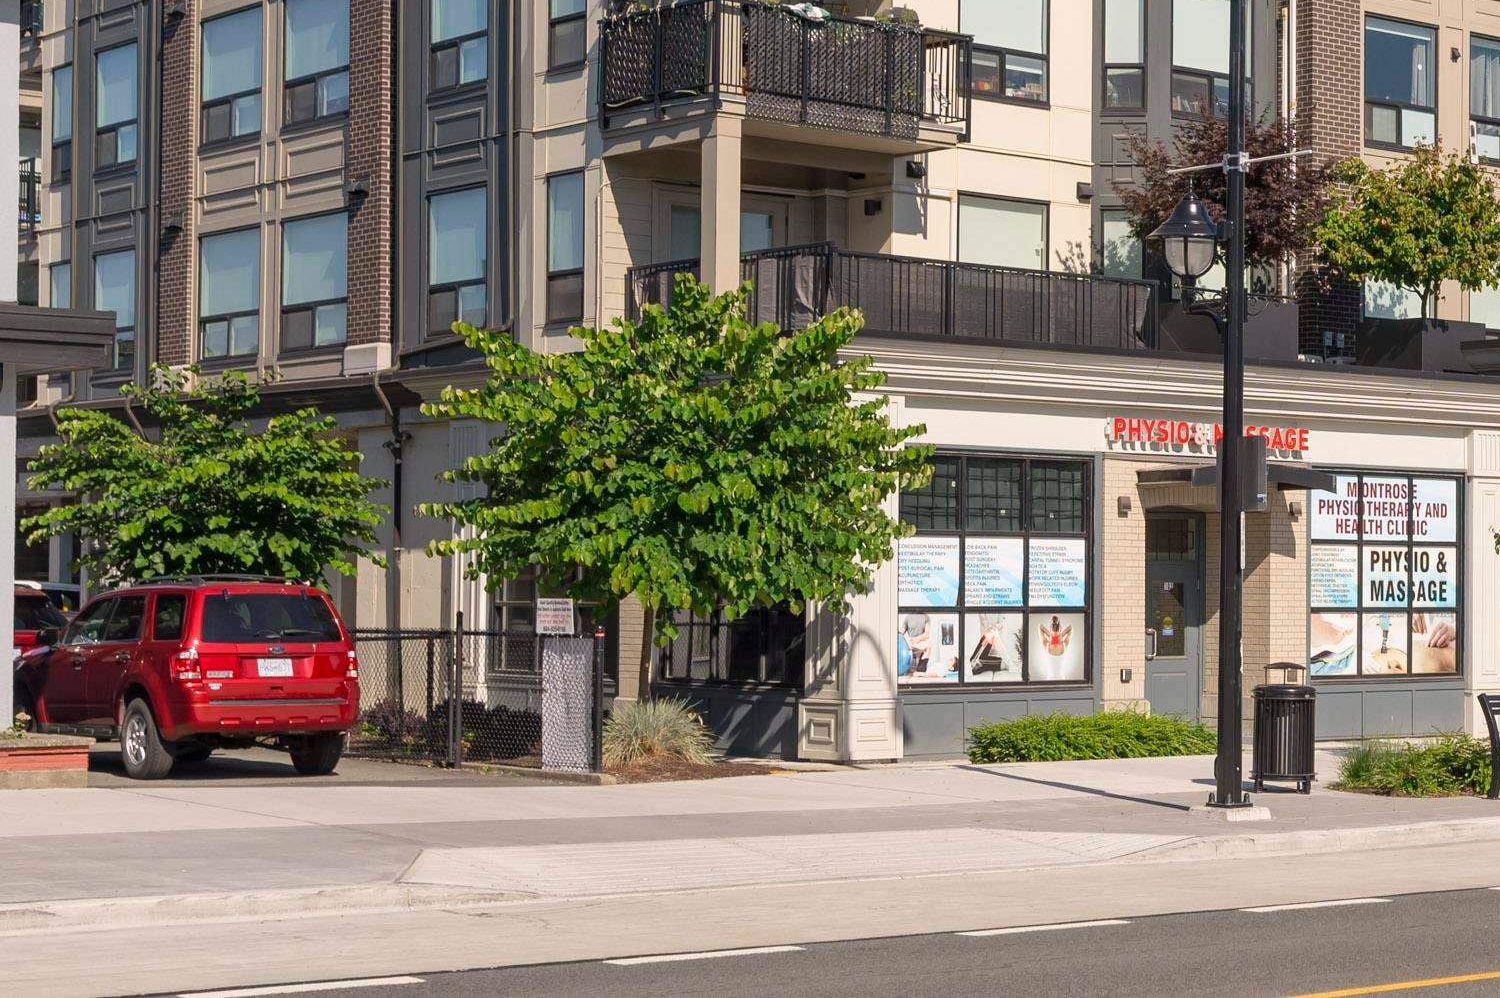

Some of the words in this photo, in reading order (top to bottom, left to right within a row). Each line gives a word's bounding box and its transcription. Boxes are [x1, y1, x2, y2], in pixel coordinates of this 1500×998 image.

[1112, 416, 1190, 444] PHYSIO
[1193, 422, 1209, 446] &
[1213, 423, 1310, 451] MSAGE
[1424, 502, 1448, 519] AND
[1335, 518, 1383, 535] HEALTH
[1369, 550, 1430, 573] PHYSIO
[1435, 551, 1448, 574] &
[1369, 579, 1448, 603] MASSAGE
